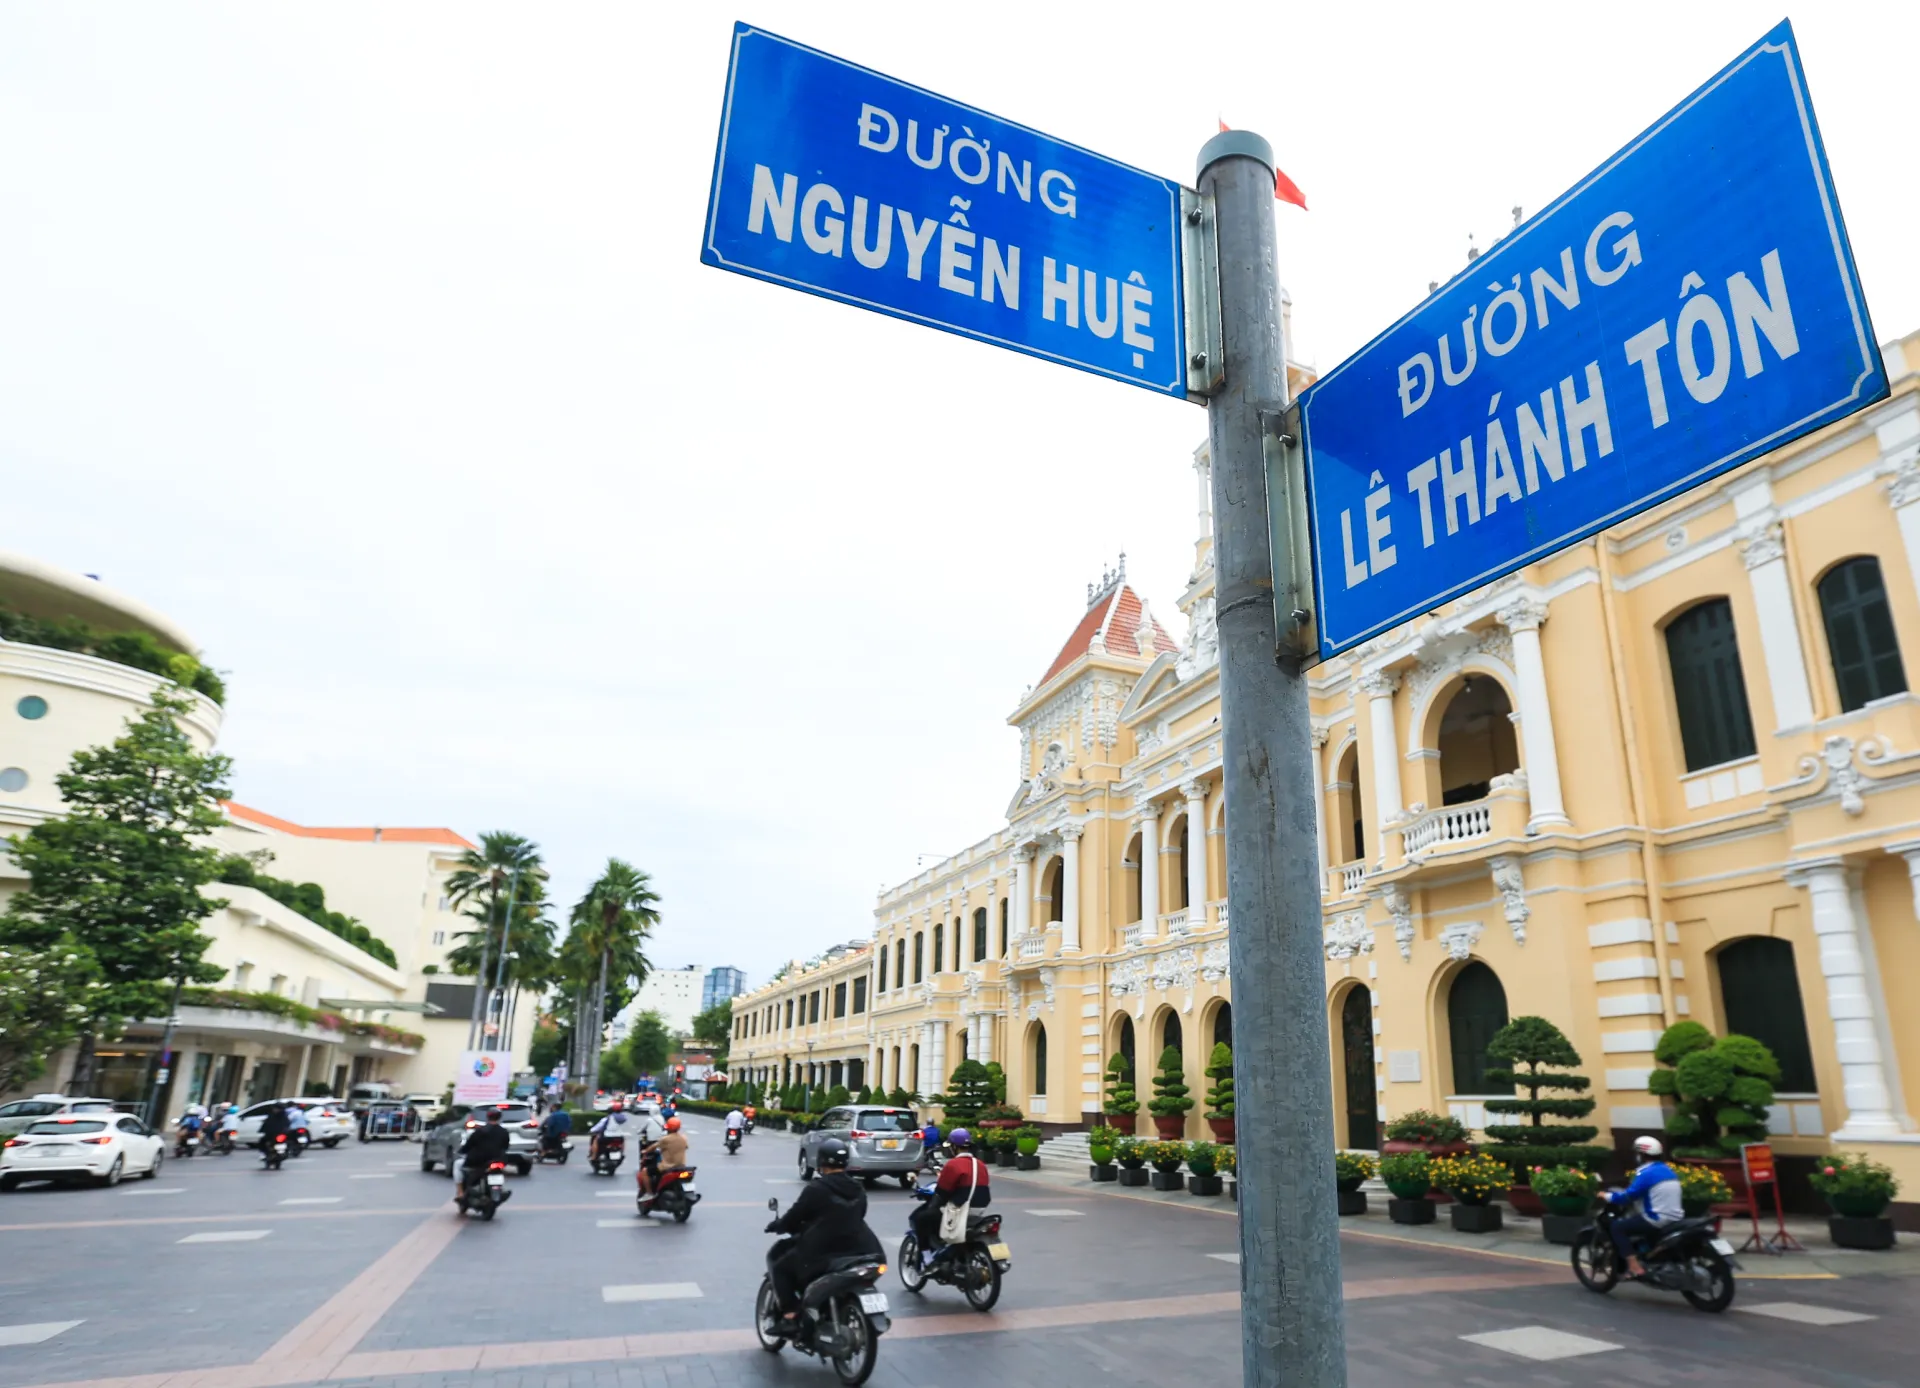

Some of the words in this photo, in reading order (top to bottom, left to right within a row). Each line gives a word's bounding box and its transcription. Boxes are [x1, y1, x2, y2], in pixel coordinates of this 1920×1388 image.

[857, 102, 1077, 219] ĐƯỜNG
[747, 163, 1020, 311] NGUYỄN
[1042, 256, 1155, 369] HUỆ
[1397, 211, 1643, 418] ĐƯỜNG
[1340, 469, 1397, 589] LÊ
[1407, 360, 1614, 549] THÁNH
[1623, 248, 1800, 429] TÔN
